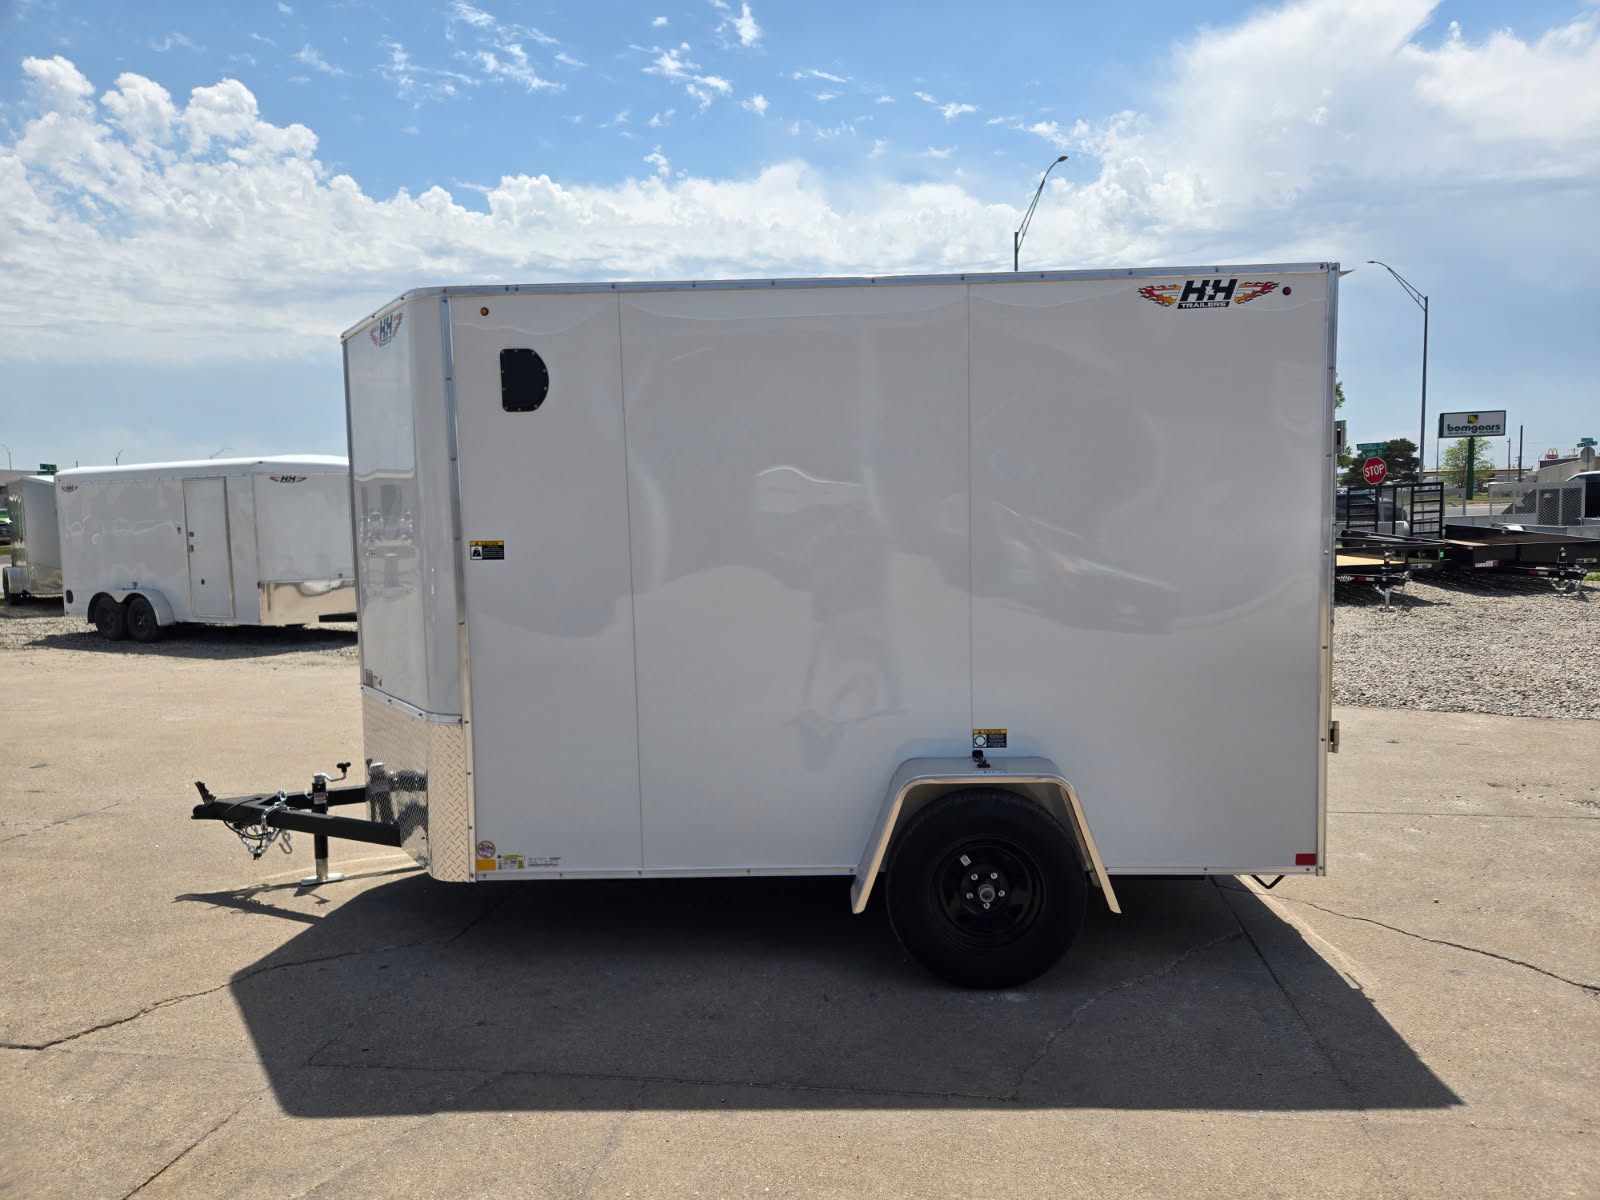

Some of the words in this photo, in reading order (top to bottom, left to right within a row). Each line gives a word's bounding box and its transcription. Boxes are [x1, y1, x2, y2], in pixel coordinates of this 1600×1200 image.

[1180, 279, 1238, 302] H&H
[1180, 301, 1227, 309] TRAILERS
[1447, 423, 1501, 434] bomgaars
[1365, 463, 1384, 478] STOP
